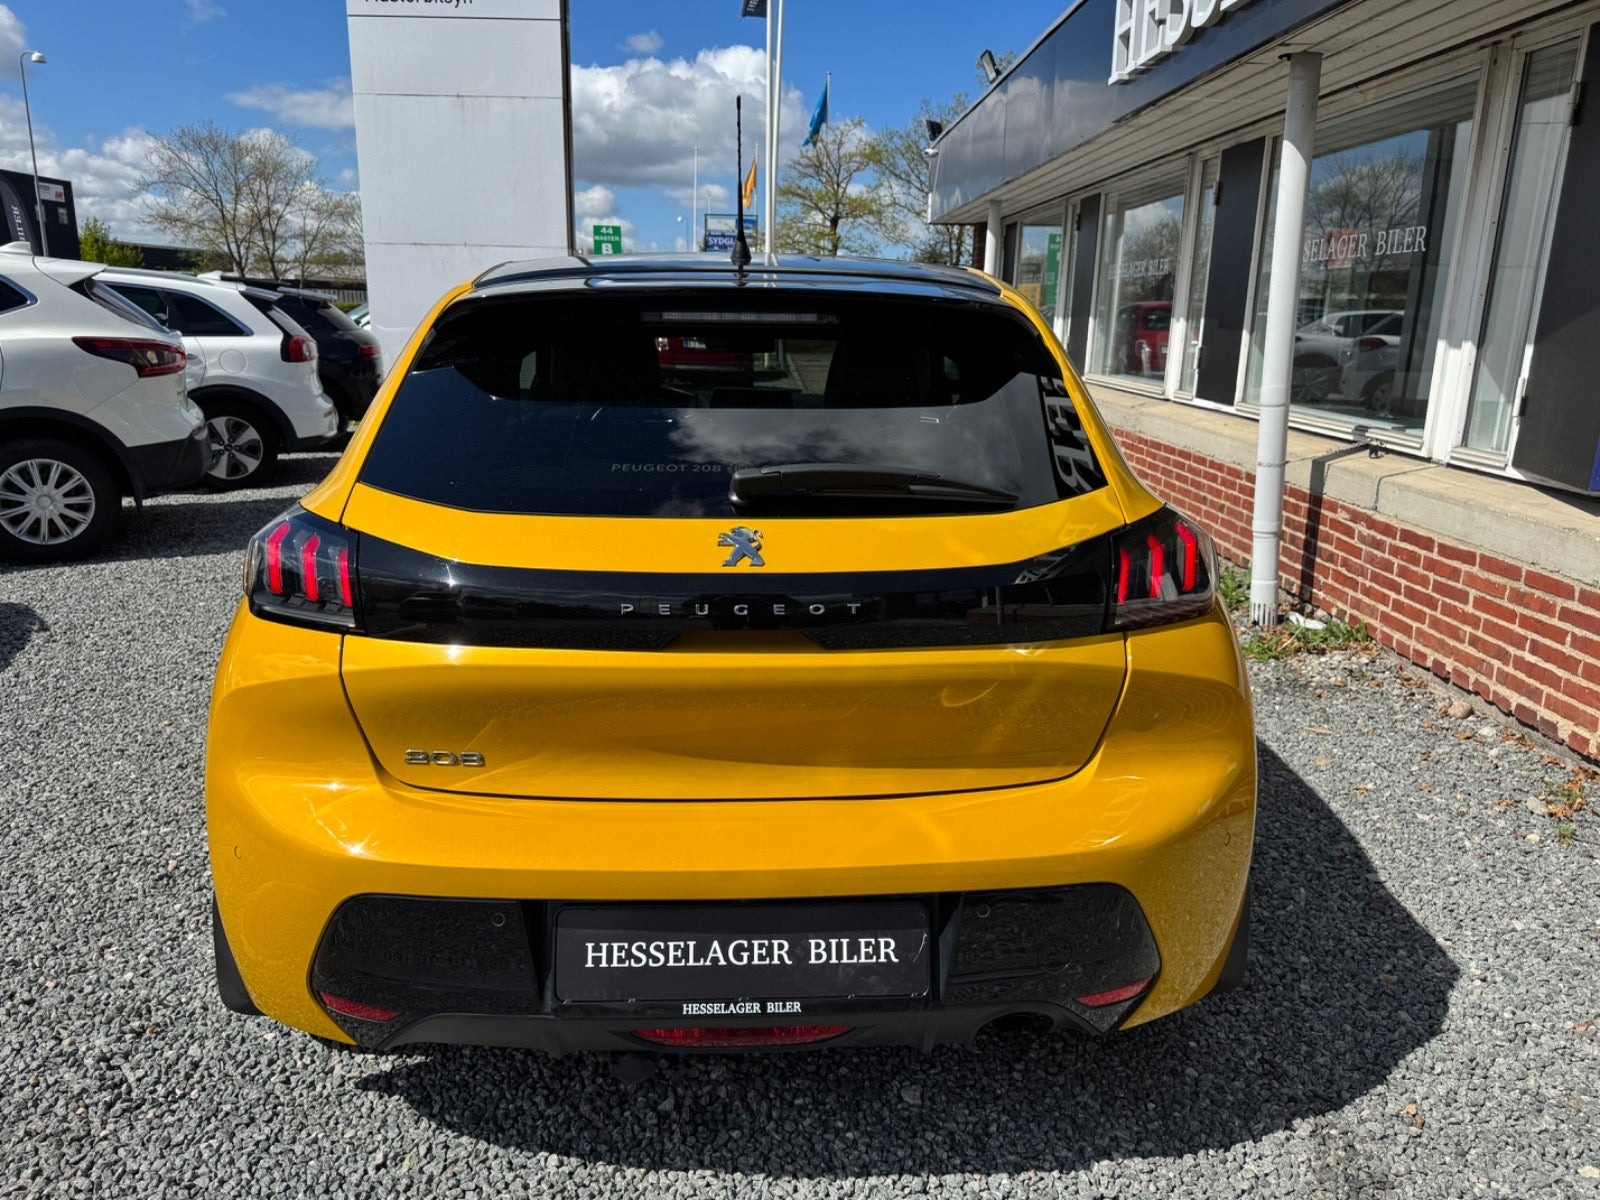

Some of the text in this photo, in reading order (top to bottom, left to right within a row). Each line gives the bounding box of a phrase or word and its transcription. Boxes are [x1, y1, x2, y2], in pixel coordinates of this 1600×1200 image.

[600, 226, 613, 234] 44
[1375, 225, 1427, 256] BILER
[602, 243, 613, 254] B
[611, 463, 687, 473] PEUGEOT
[692, 463, 721, 473] 208
[620, 603, 861, 615] PEUGEOT
[405, 749, 484, 766] 208
[585, 937, 899, 968] HESSELAGER BILER
[682, 1001, 802, 1016] HESSELAGER BILER
